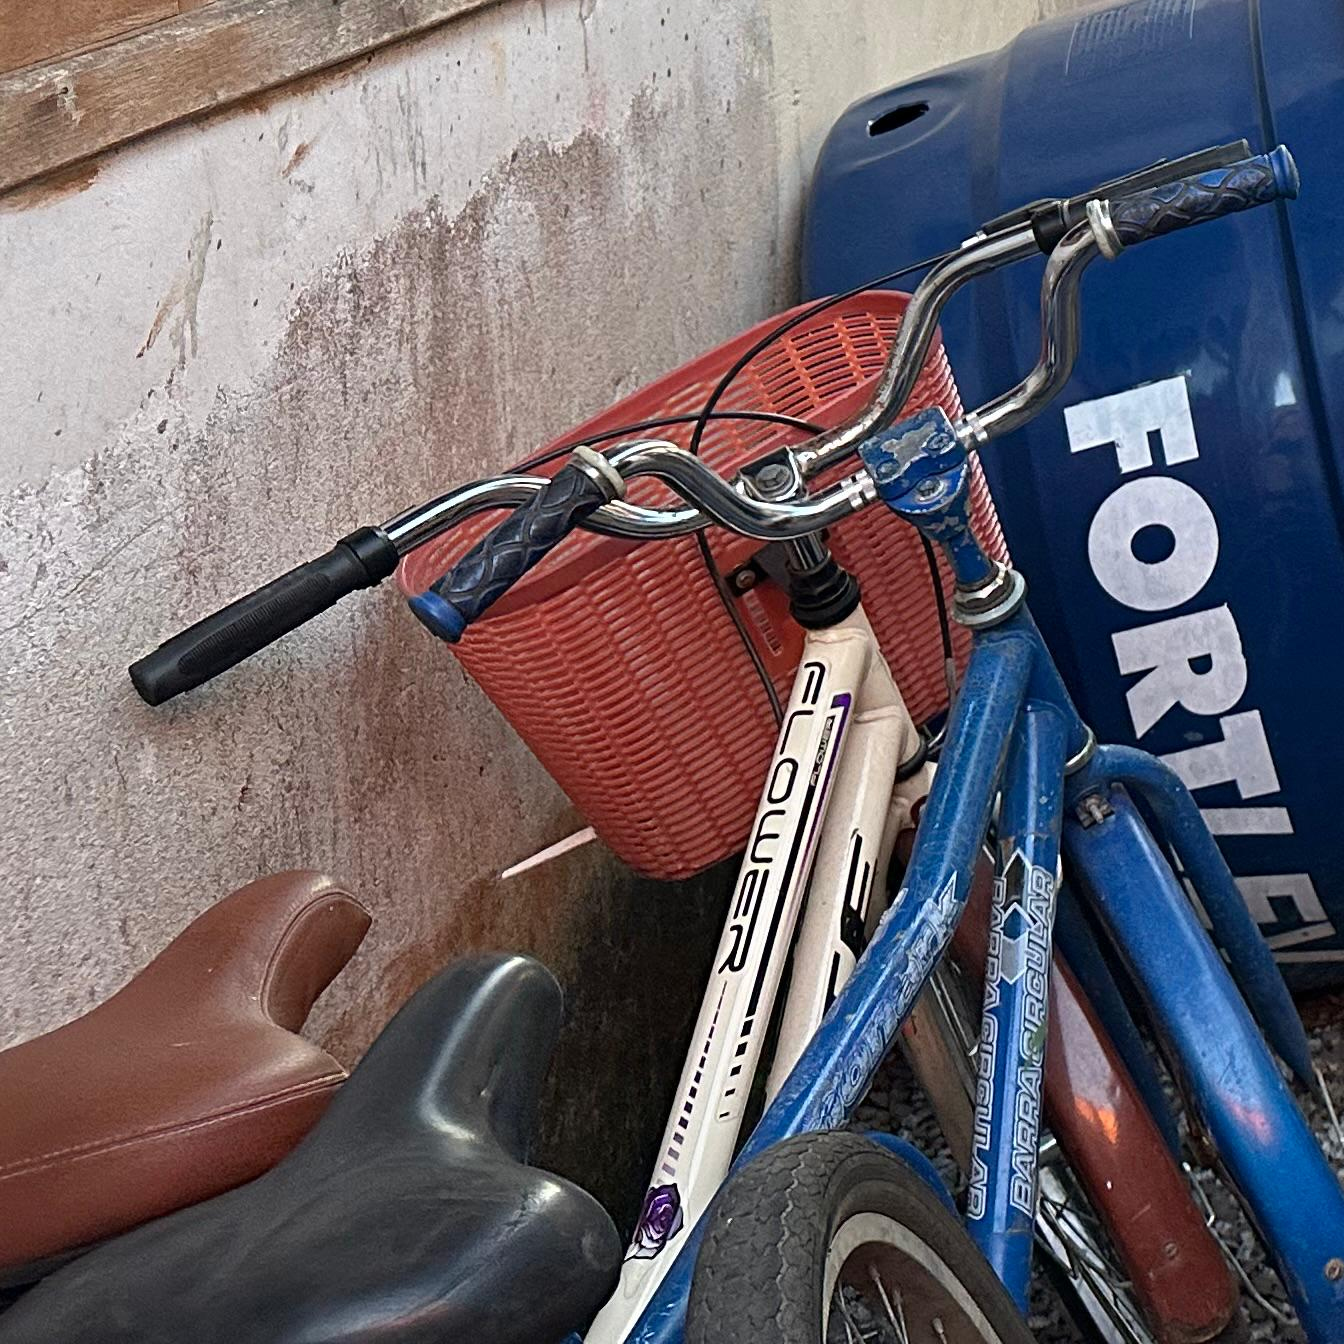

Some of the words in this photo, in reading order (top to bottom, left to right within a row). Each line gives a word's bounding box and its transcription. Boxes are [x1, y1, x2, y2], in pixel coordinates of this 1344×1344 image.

[718, 661, 826, 975] FLOWER
[809, 716, 835, 787] FLOWER
[1018, 865, 1055, 1068] CIRCULAR
[1010, 1066, 1043, 1219] BARRA
